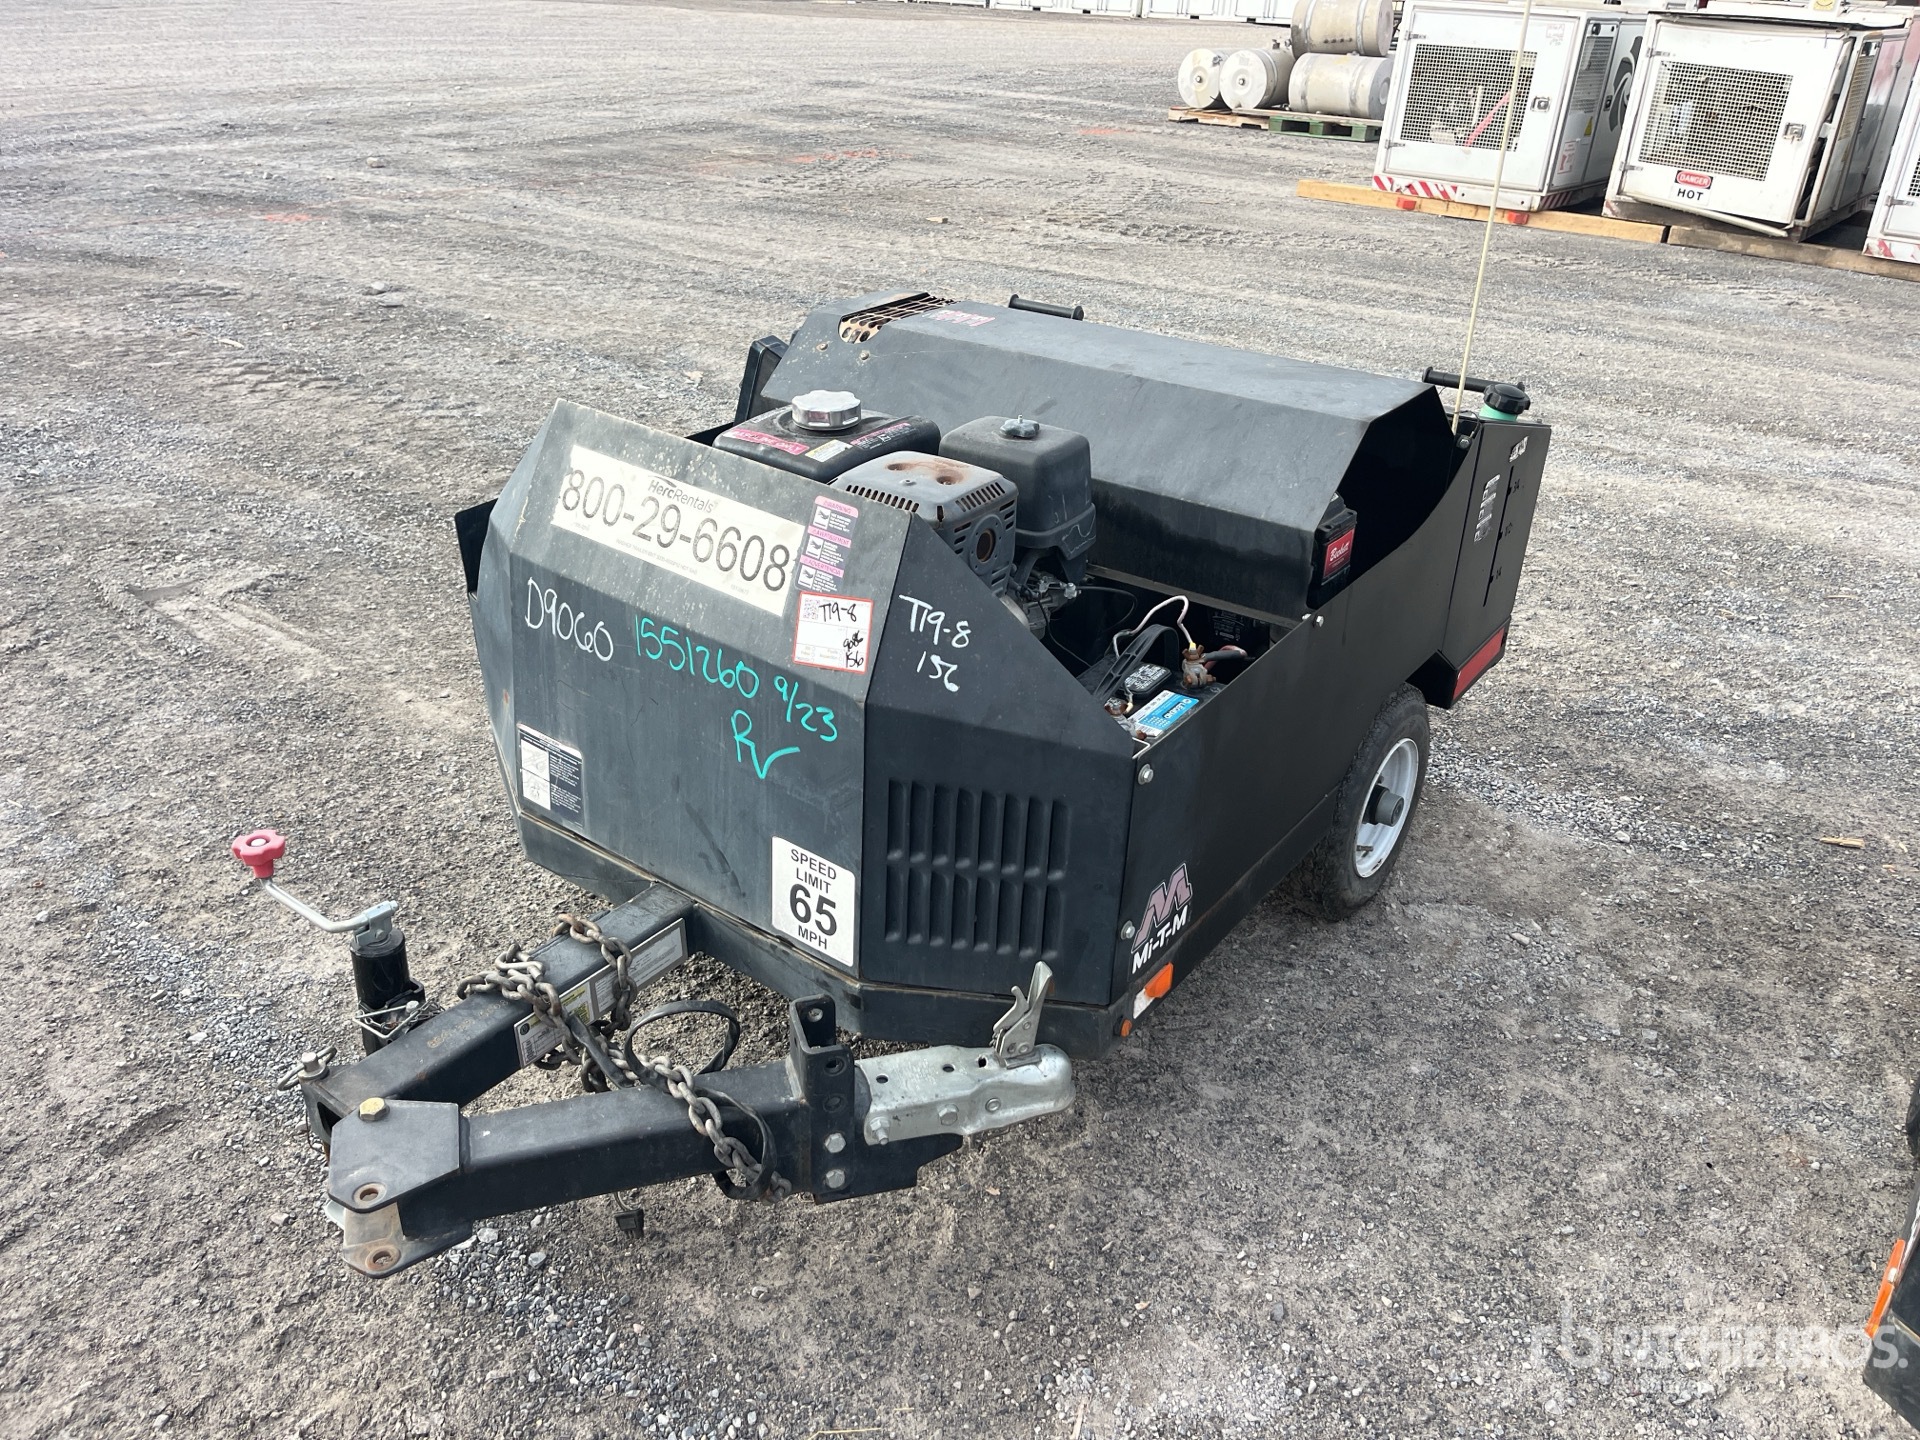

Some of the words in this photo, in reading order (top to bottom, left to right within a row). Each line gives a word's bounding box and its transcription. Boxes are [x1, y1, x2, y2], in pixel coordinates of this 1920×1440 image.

[1677, 188, 1704, 201] HOT
[1680, 172, 1709, 186] DANGER
[648, 478, 714, 514] HercRentals
[562, 469, 790, 592] 800-29-6608
[525, 577, 614, 662] D9060
[635, 614, 760, 698] 1551260
[791, 849, 837, 880] SPEED
[796, 867, 831, 894] LIMIT
[790, 883, 837, 937] 65
[798, 925, 828, 950] MPH
[1132, 904, 1188, 974] Mi-T-M
